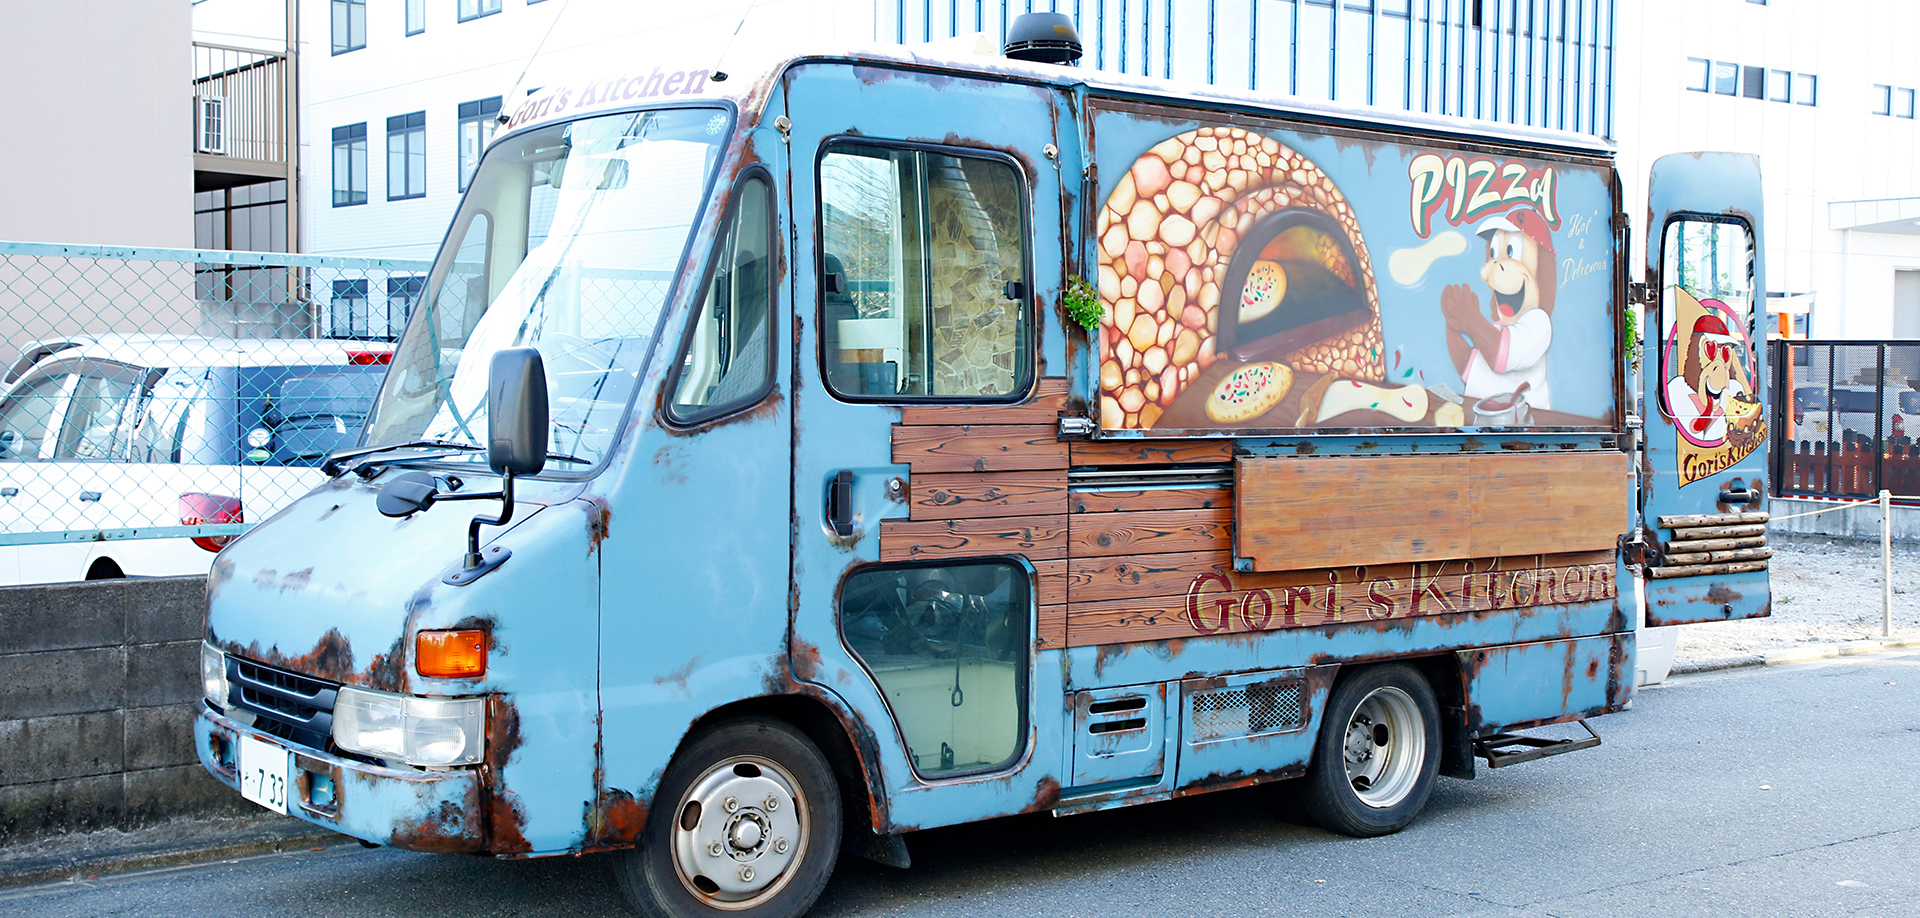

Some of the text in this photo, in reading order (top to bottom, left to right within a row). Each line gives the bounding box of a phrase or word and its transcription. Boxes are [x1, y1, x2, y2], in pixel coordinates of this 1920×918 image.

[508, 65, 710, 130] Gori's Kitchen
[1578, 238, 1585, 250] &
[1186, 554, 1613, 636] Gori's Kitchen
